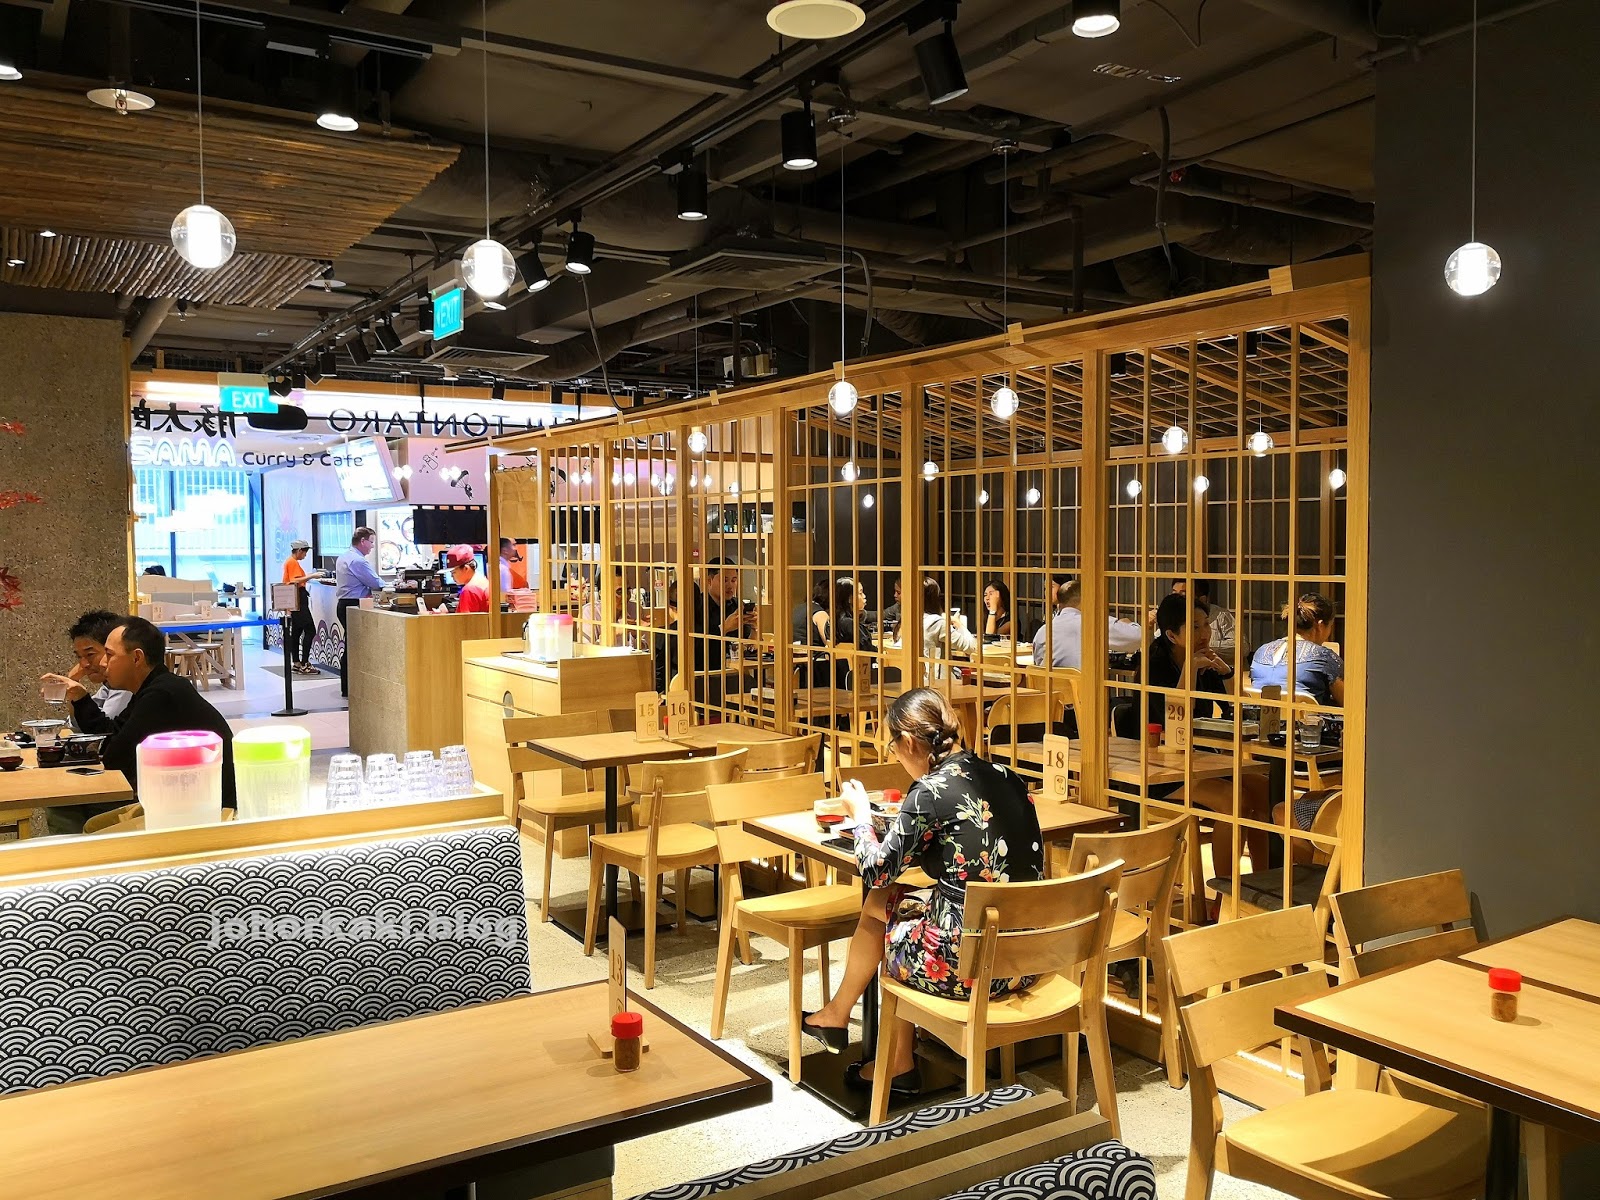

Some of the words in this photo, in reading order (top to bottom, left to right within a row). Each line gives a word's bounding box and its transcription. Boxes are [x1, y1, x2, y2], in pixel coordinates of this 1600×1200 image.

[441, 296, 460, 328] EXIT
[231, 390, 265, 409] EXIT
[242, 452, 296, 468] Curry
[302, 453, 315, 467] &
[320, 453, 364, 467] Cafe
[640, 704, 655, 717] 15
[671, 702, 686, 716] 16
[1167, 704, 1185, 721] 29
[1046, 750, 1065, 769] 18
[611, 949, 623, 987] 13
